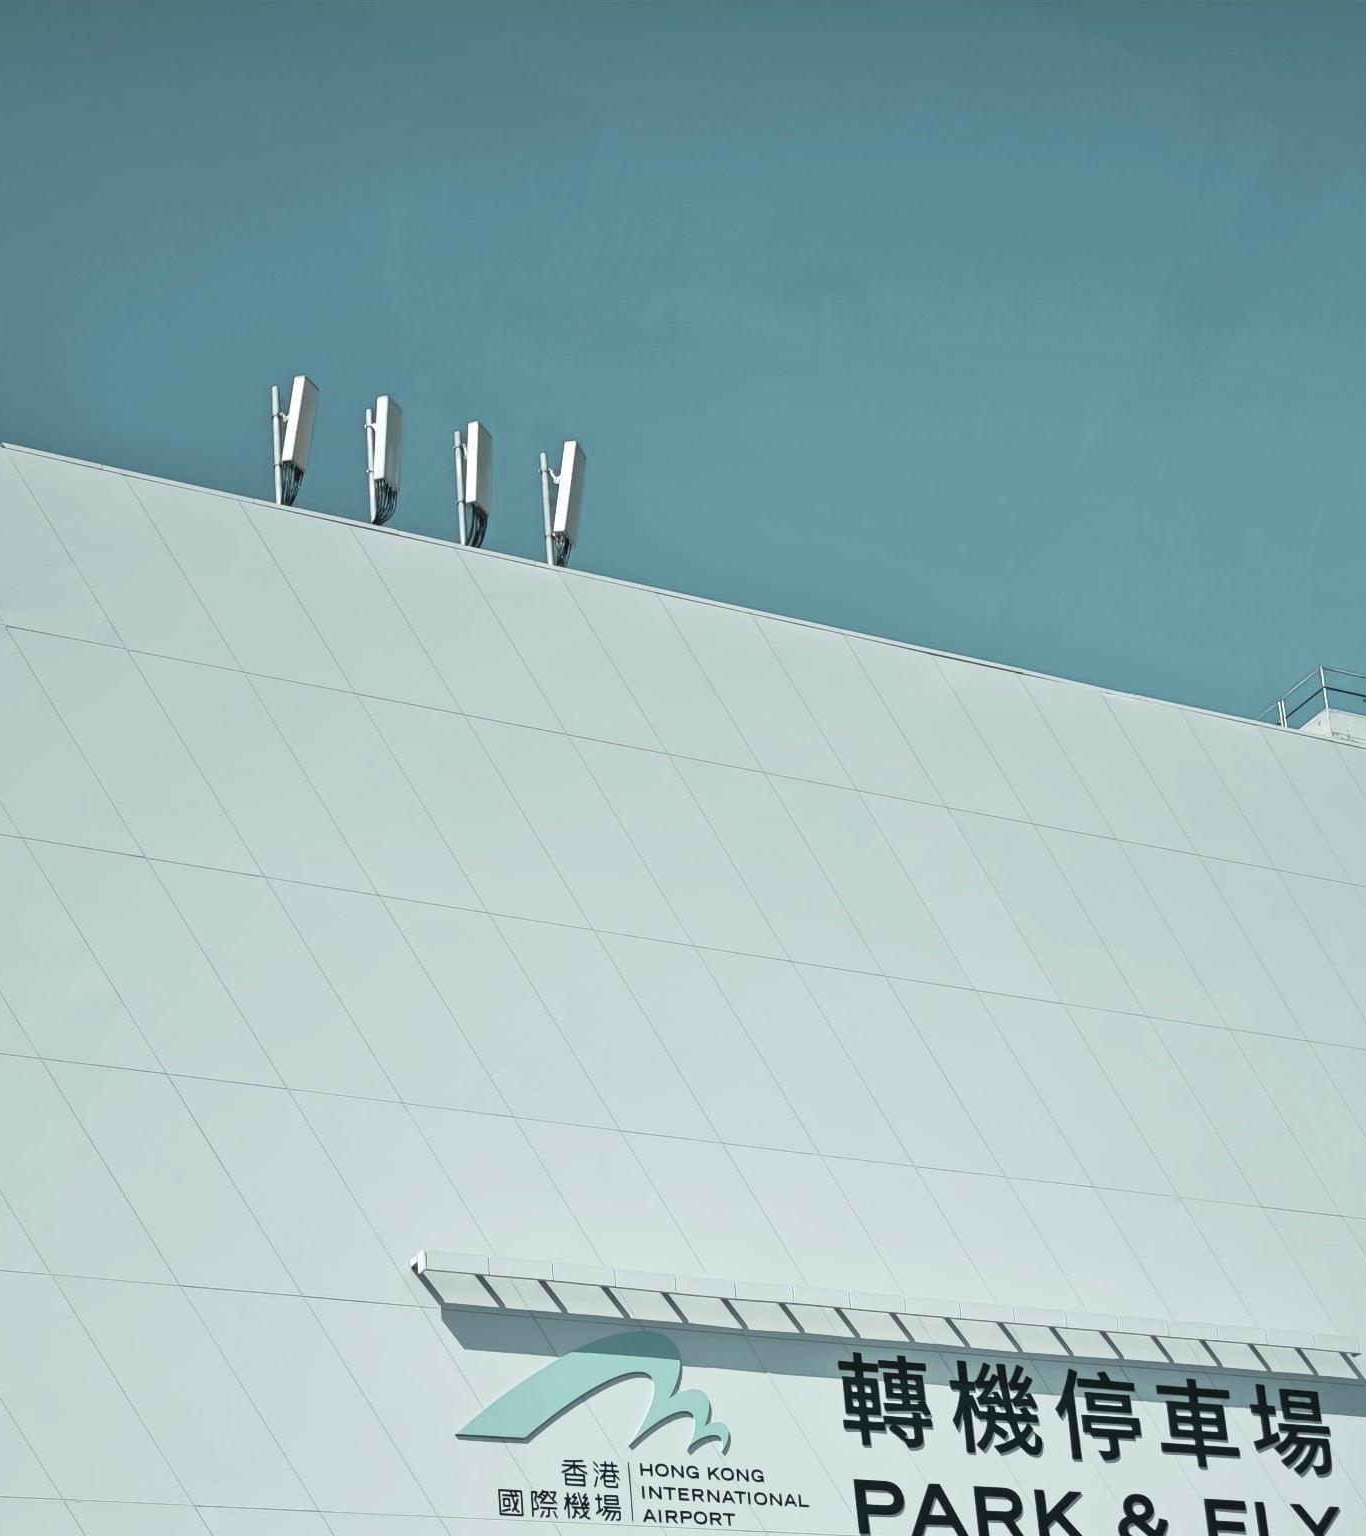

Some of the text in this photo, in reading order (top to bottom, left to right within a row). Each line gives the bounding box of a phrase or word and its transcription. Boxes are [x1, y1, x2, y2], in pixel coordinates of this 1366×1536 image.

[838, 1352, 1333, 1476] 轉機停車場
[561, 1459, 620, 1489] 香港
[639, 1462, 765, 1483] HONG KONG
[497, 1487, 622, 1522] 國際機場
[641, 1485, 810, 1508] INTERNATIONAL
[642, 1508, 736, 1527] AIRPORT
